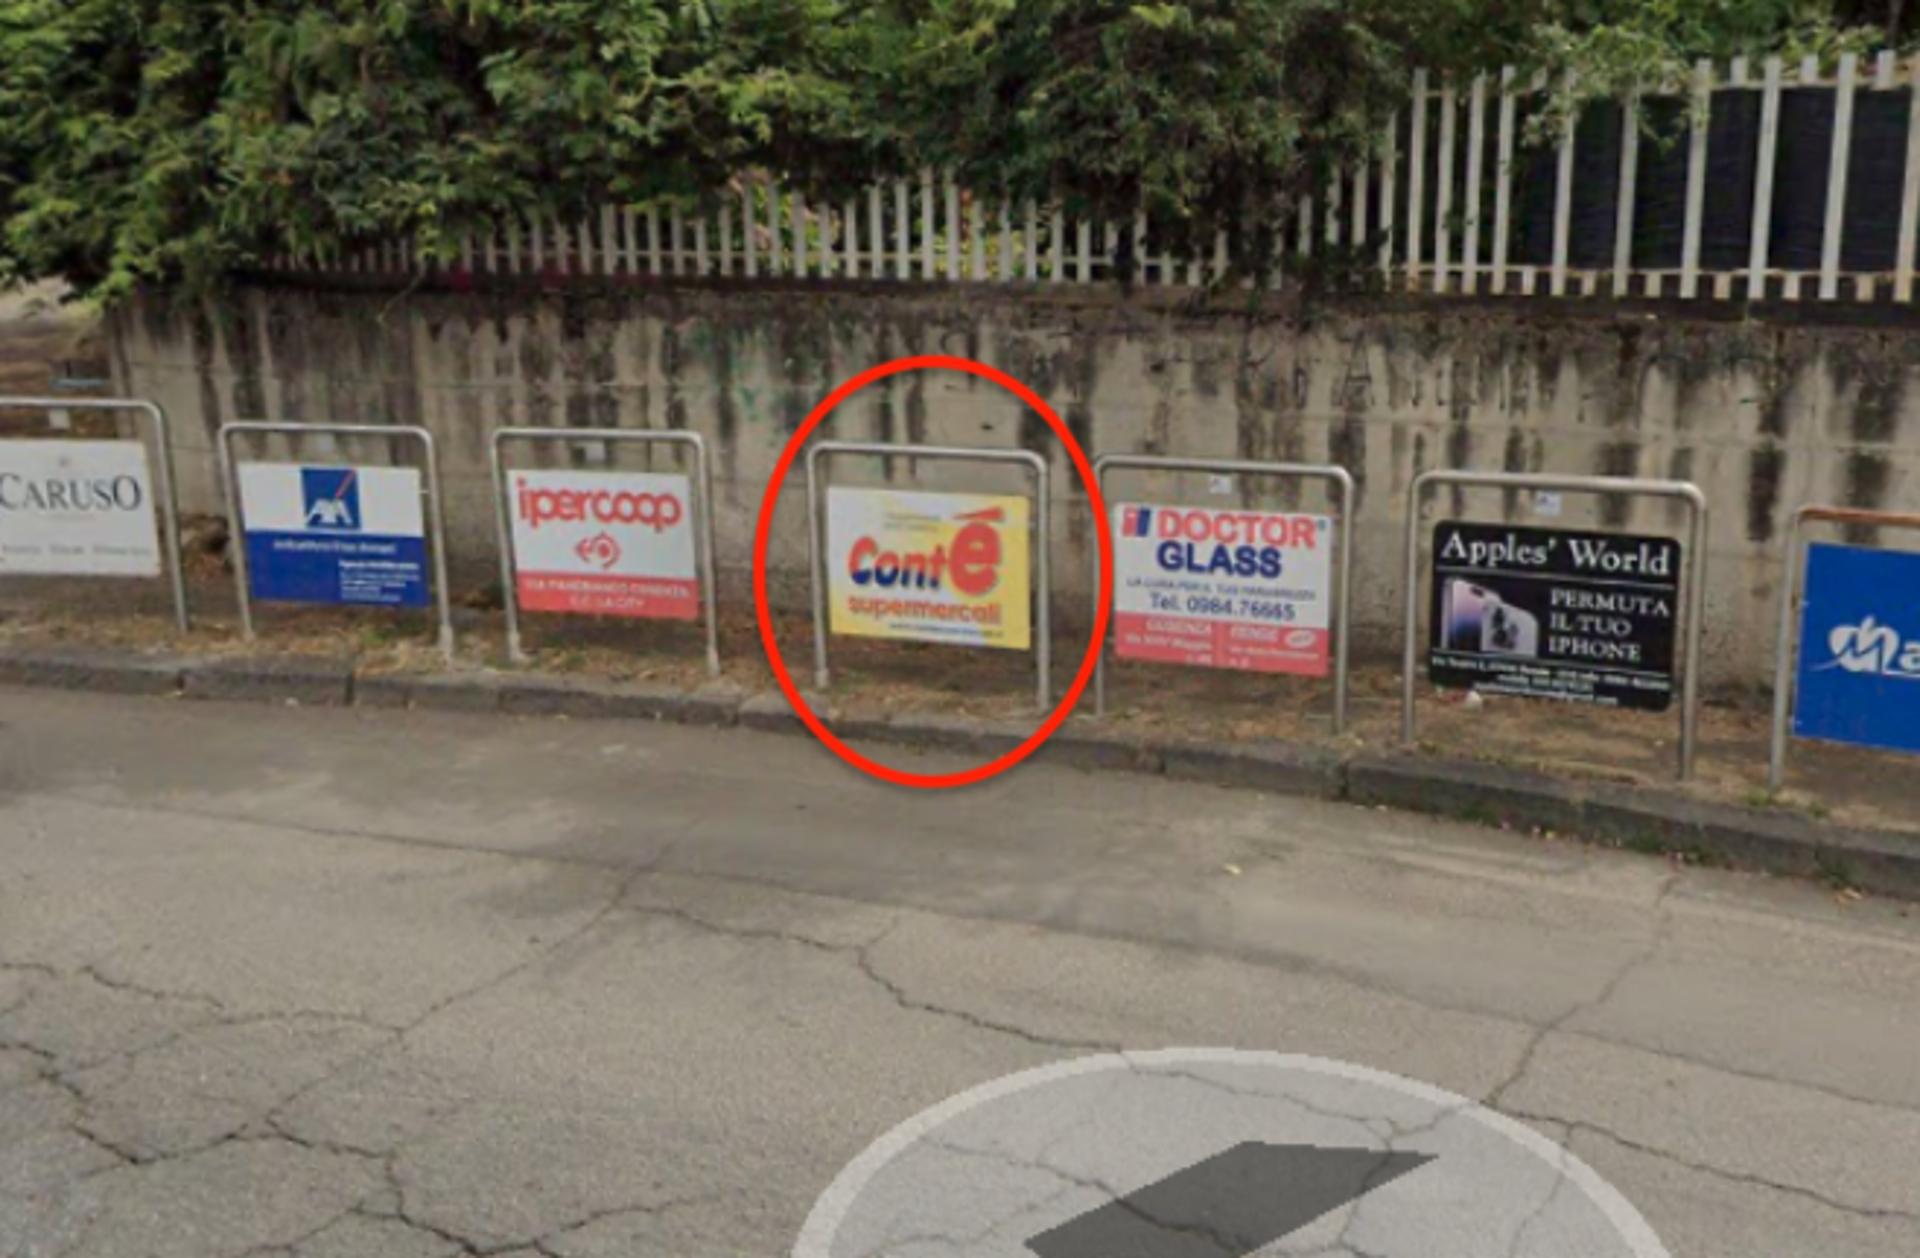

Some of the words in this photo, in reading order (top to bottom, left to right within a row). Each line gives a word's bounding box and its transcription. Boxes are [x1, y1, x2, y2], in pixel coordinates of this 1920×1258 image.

[0, 472, 141, 511] CARUSO
[516, 476, 683, 532] ipercoop
[1156, 508, 1317, 549] DOCTOR
[847, 505, 1005, 597] Conté
[1156, 540, 1283, 579] GLASS
[1441, 530, 1557, 569] Apples'
[1568, 538, 1671, 576] World
[1551, 587, 1670, 617] PERMUTA
[1551, 612, 1572, 632] IL
[1576, 615, 1632, 637] TUO
[1549, 635, 1642, 663] IPHONE
